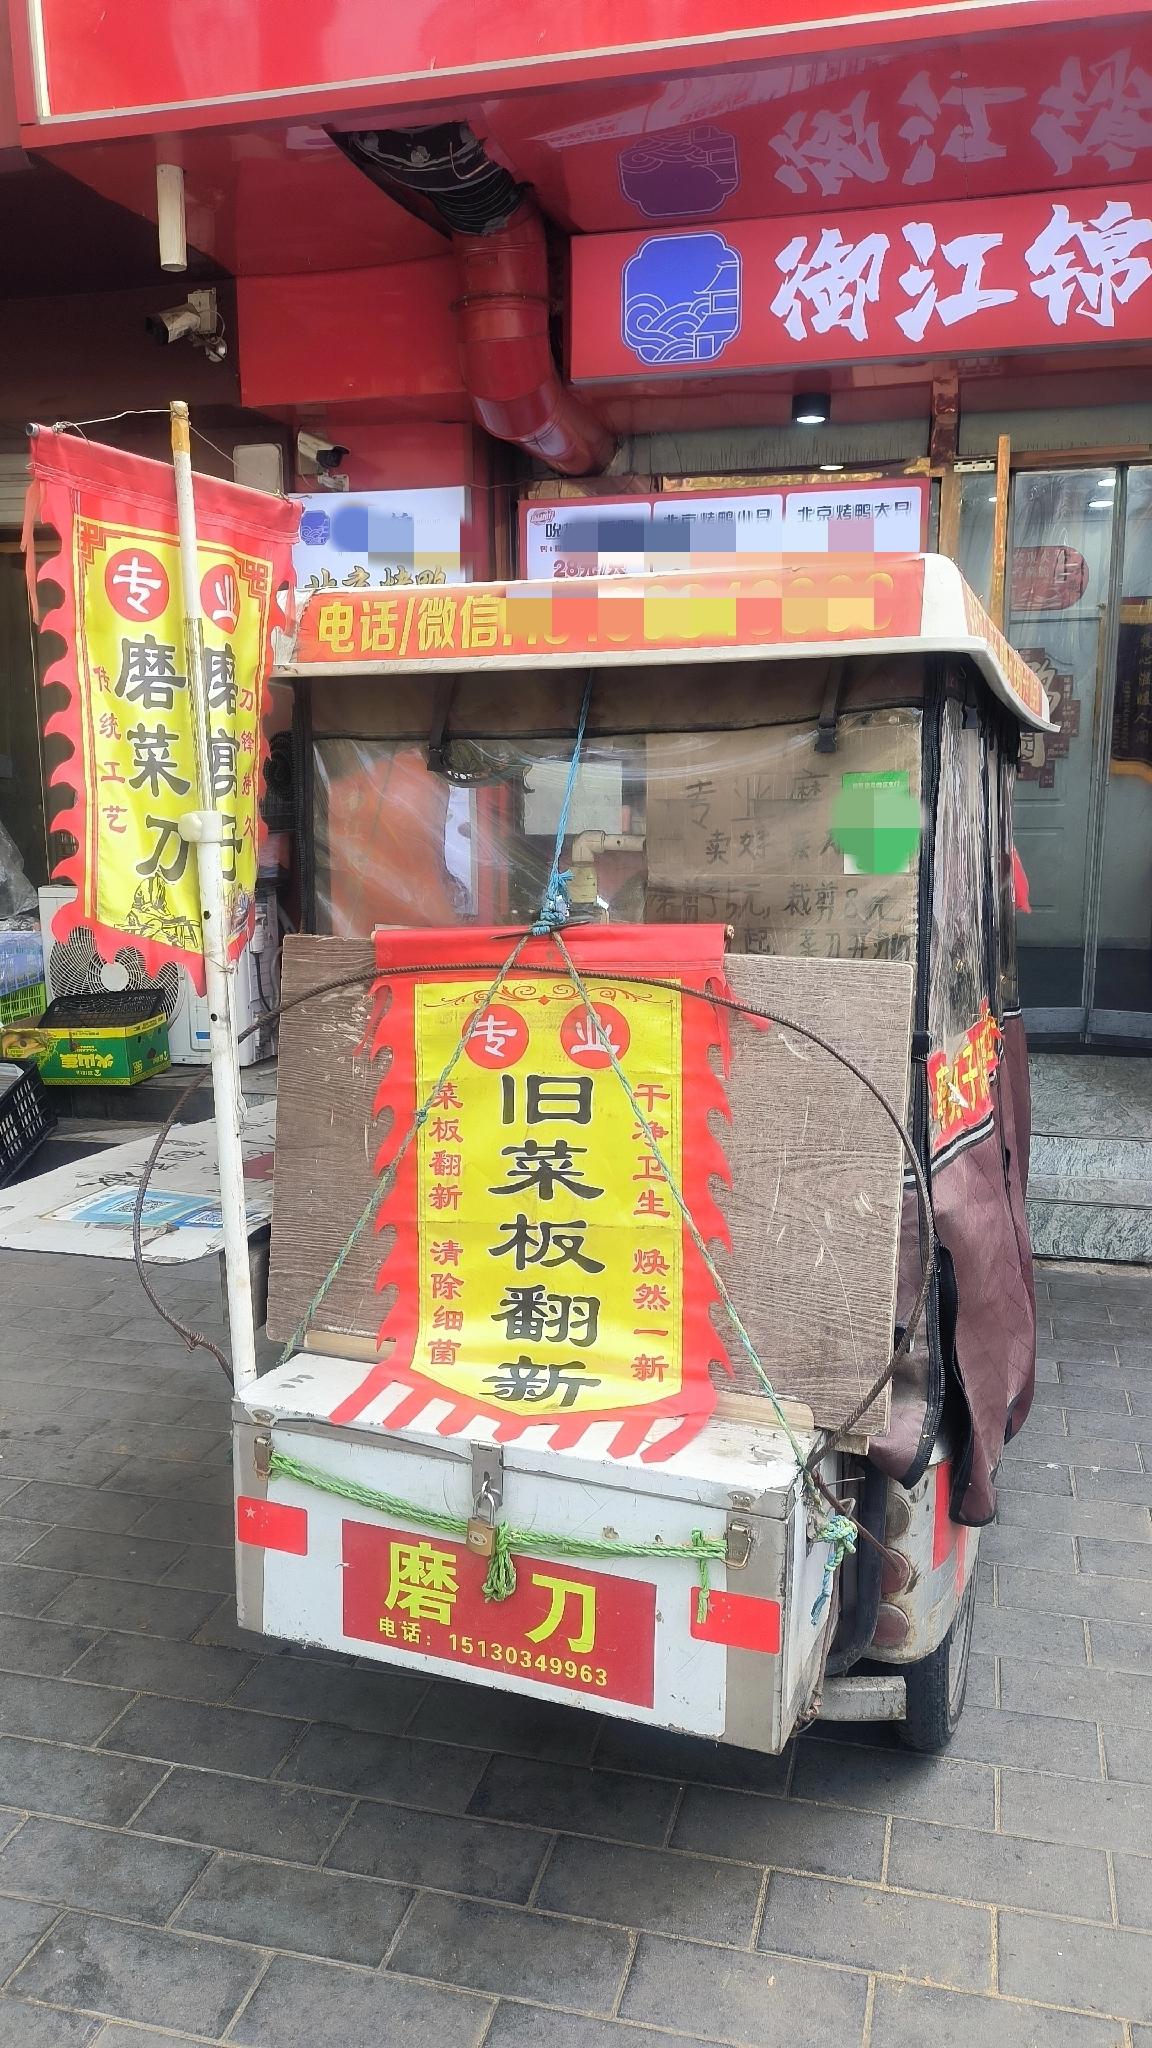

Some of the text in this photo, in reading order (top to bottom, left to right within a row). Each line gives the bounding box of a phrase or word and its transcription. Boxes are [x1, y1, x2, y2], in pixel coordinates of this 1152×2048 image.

[770, 201, 1152, 342] 御江锦
[93, 664, 128, 834] 传统工艺
[115, 634, 190, 881] 磨菜刀
[238, 687, 255, 840] 刀锋持久
[471, 1014, 621, 1058] 专业
[428, 1082, 465, 1367] 菜板翻新 清除细菌
[480, 1073, 605, 1408] 旧菜板翻新
[631, 1082, 672, 1384] 干净卫生 焕然一新
